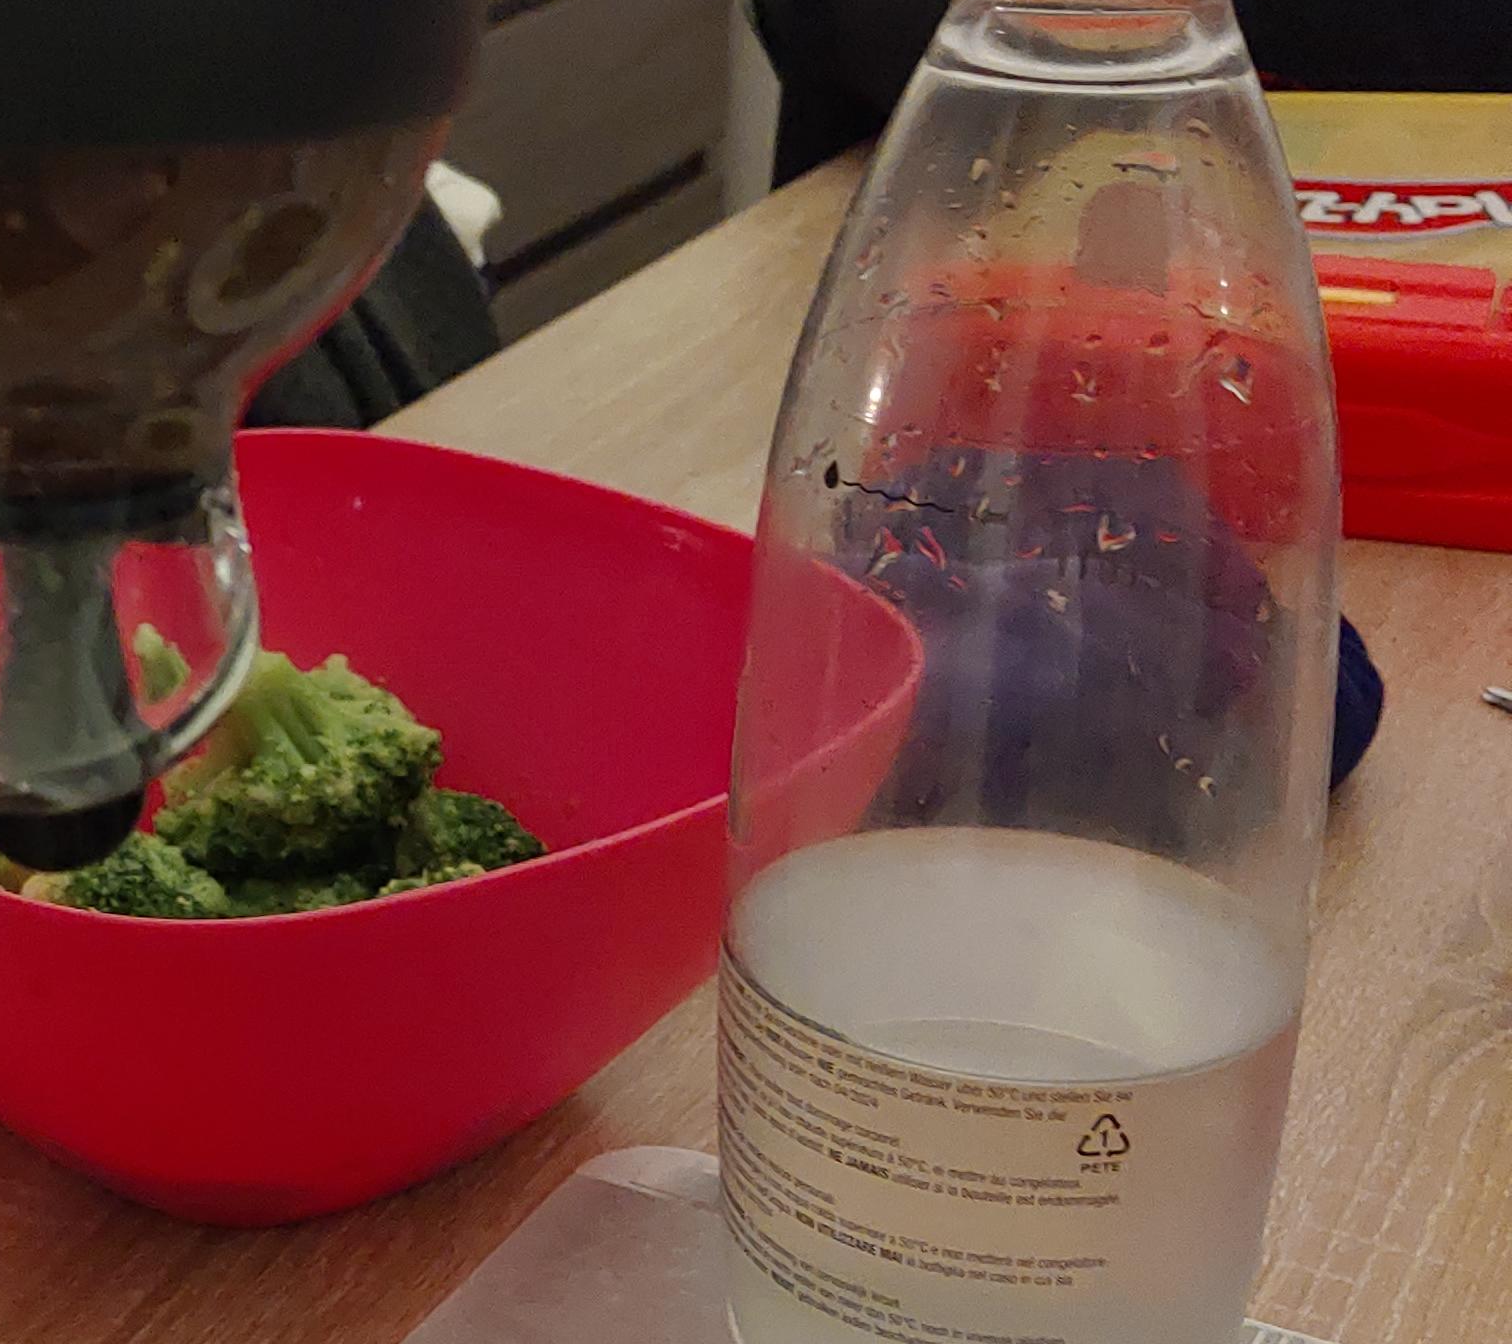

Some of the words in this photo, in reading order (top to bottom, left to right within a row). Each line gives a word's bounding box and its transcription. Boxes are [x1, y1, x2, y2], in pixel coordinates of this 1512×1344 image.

[986, 1086, 1020, 1101] 50°C
[1092, 1090, 1114, 1103] Sie
[1023, 1107, 1044, 1121] Sie
[844, 1155, 889, 1179] JAMAIS
[1080, 1162, 1121, 1174] PETE
